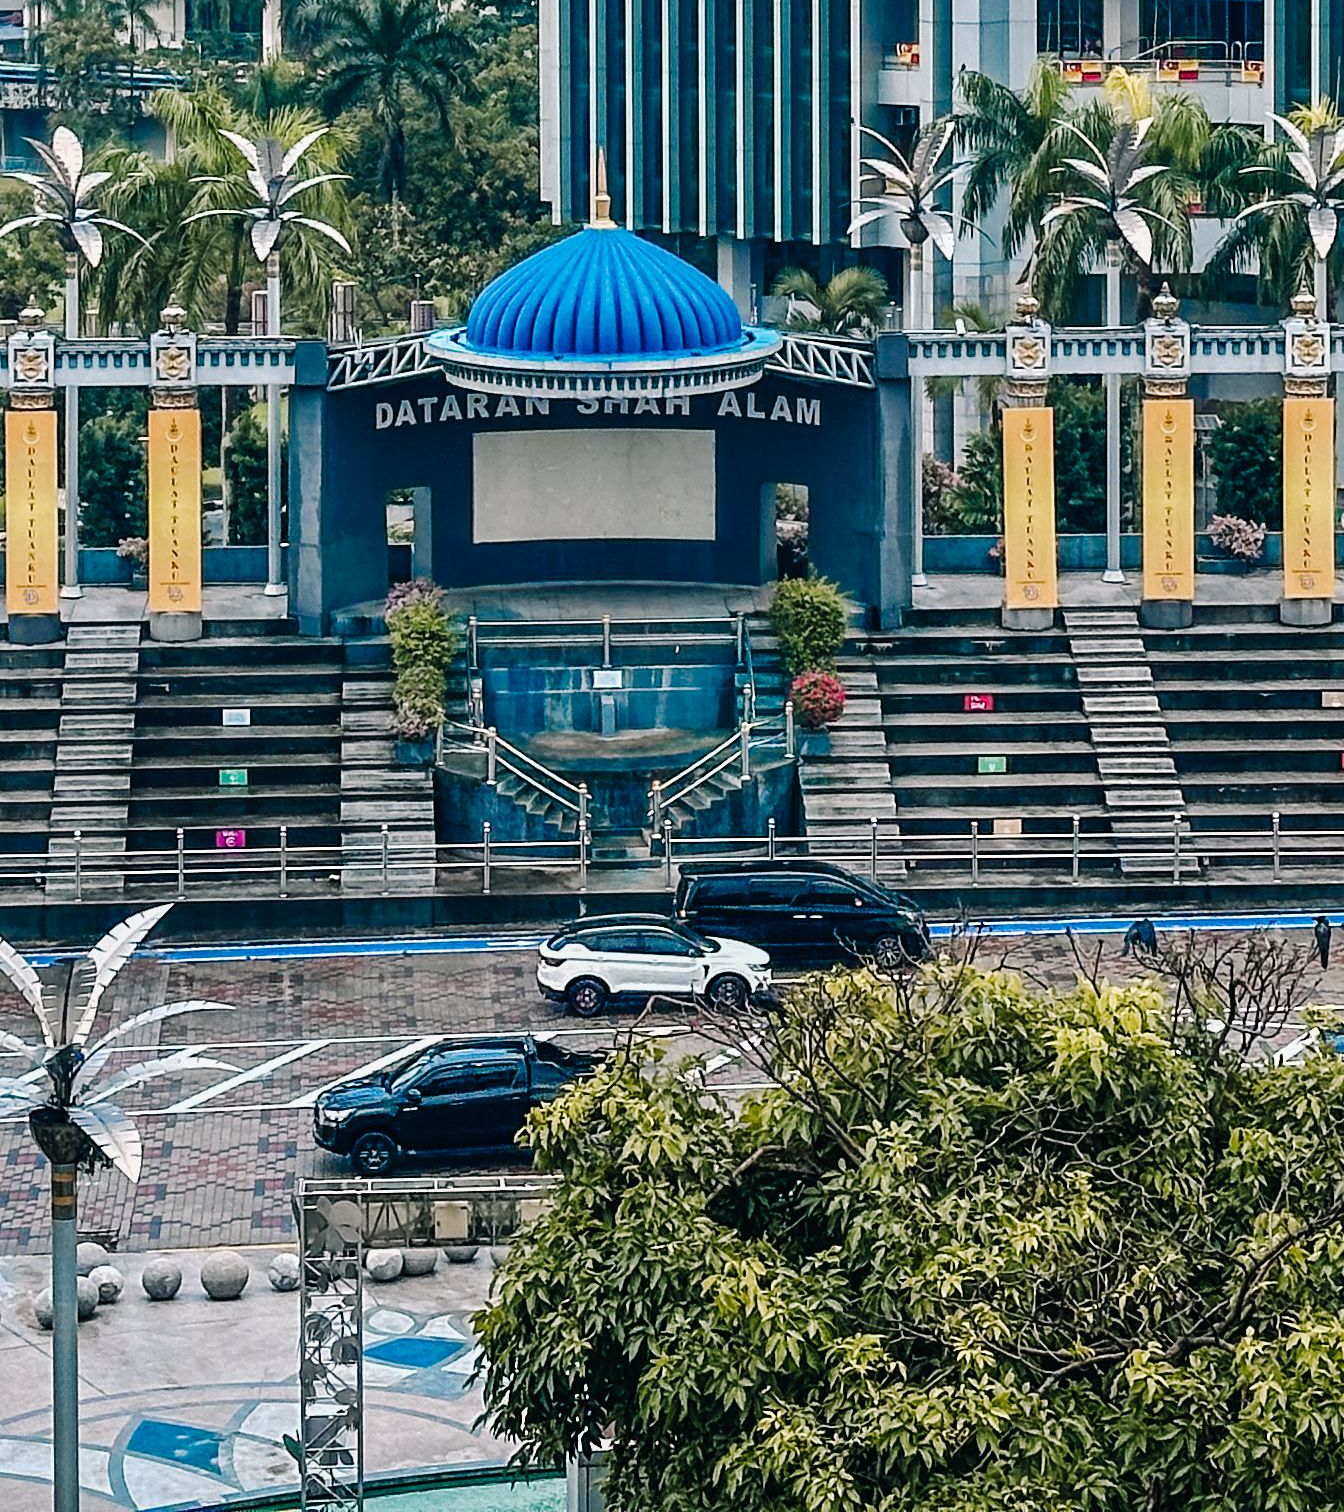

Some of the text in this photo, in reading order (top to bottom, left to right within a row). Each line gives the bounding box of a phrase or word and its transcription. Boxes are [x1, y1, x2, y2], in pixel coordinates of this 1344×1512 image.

[375, 391, 822, 430] DATARAN SHAH ALAM
